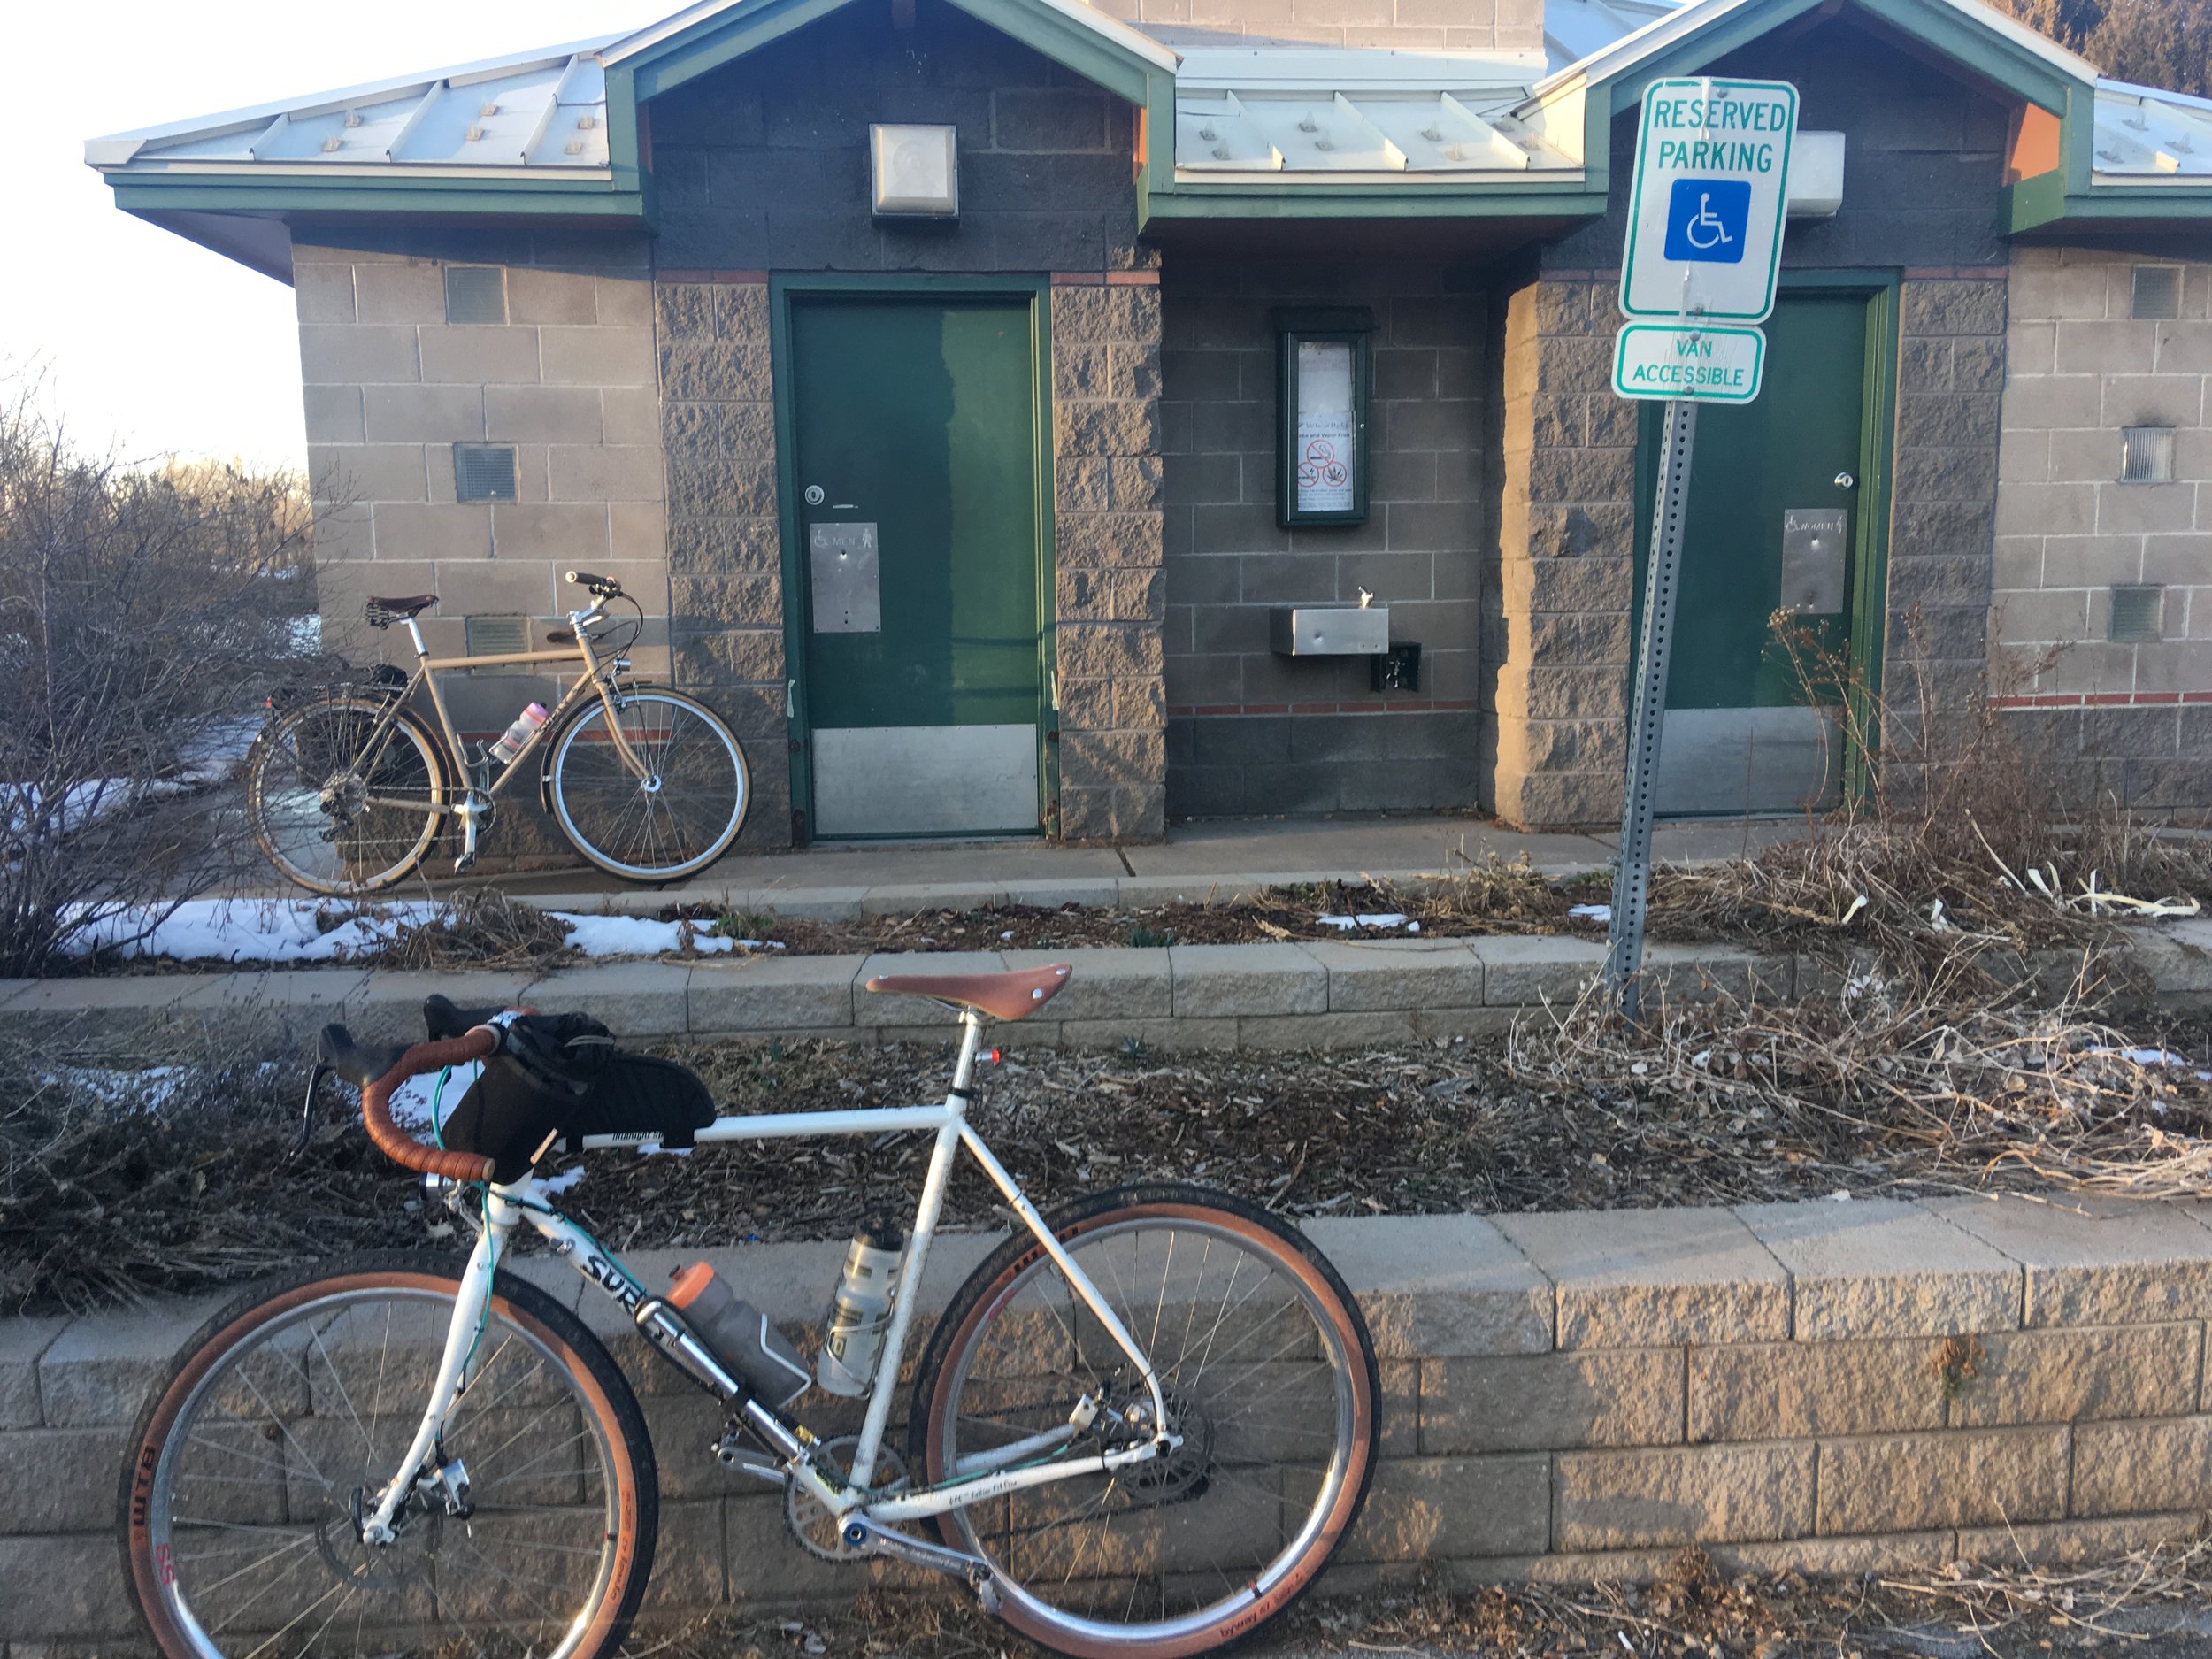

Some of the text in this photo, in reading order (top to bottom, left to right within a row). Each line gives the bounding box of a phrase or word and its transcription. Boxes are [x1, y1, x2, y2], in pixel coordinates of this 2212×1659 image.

[1654, 98, 1786, 132] RESERVED
[1658, 141, 1773, 173] PARKING
[1676, 339, 1713, 357] VAN
[1632, 363, 1745, 387] ACCESSIBLE
